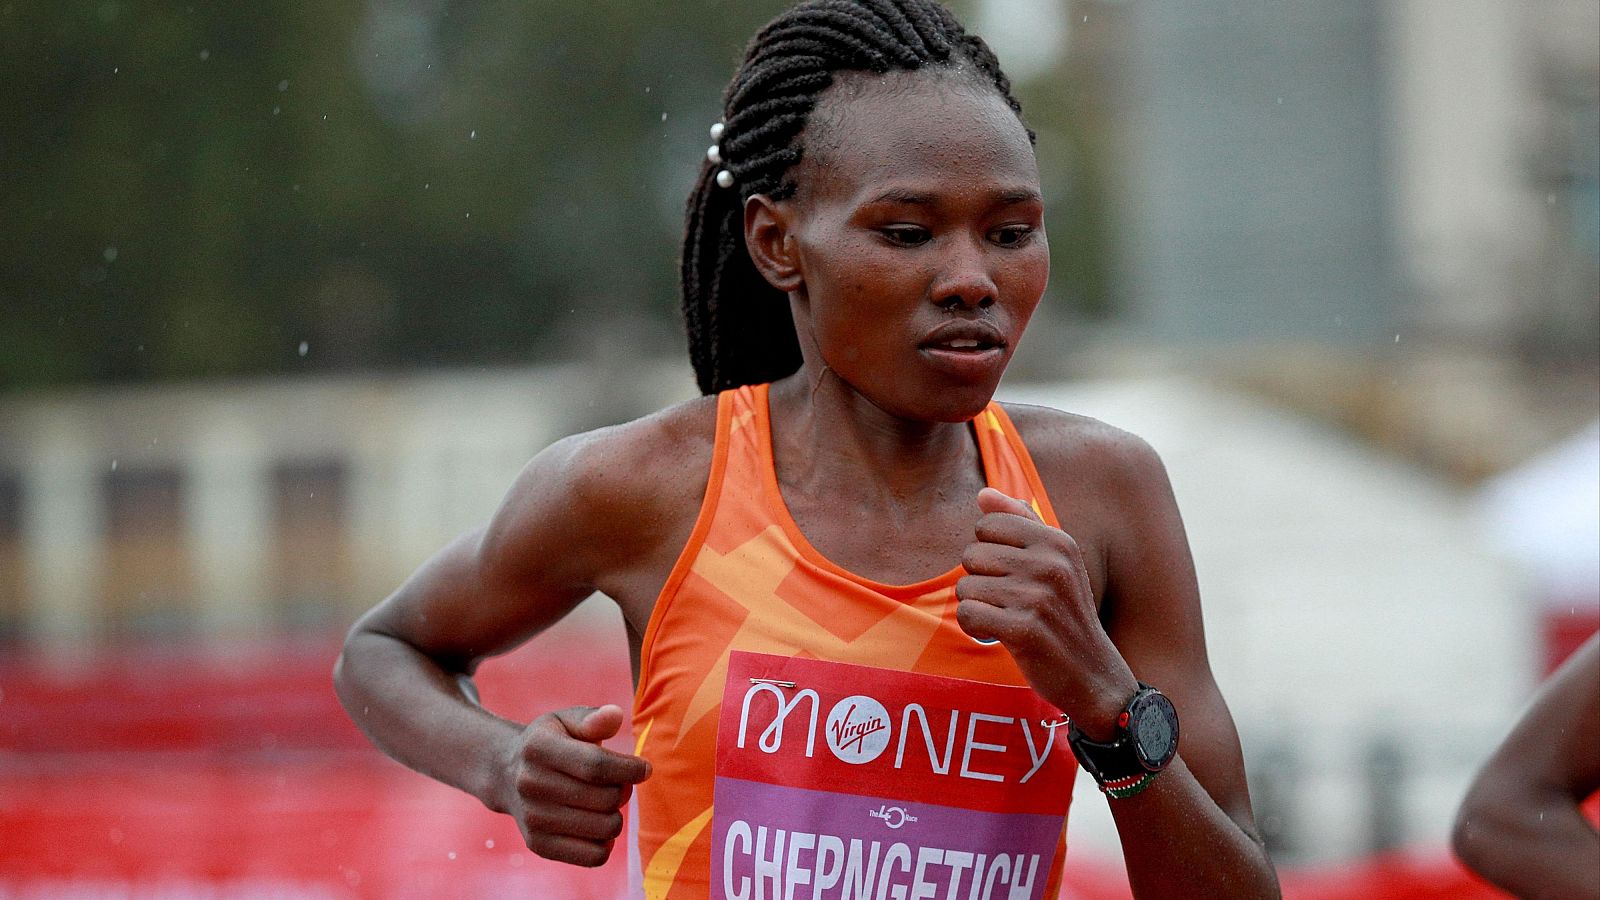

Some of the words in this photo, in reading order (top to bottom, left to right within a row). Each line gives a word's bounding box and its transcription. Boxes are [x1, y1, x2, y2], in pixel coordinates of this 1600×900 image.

[831, 703, 886, 753] Virgin
[869, 809, 879, 818] The
[905, 813, 918, 823] Race
